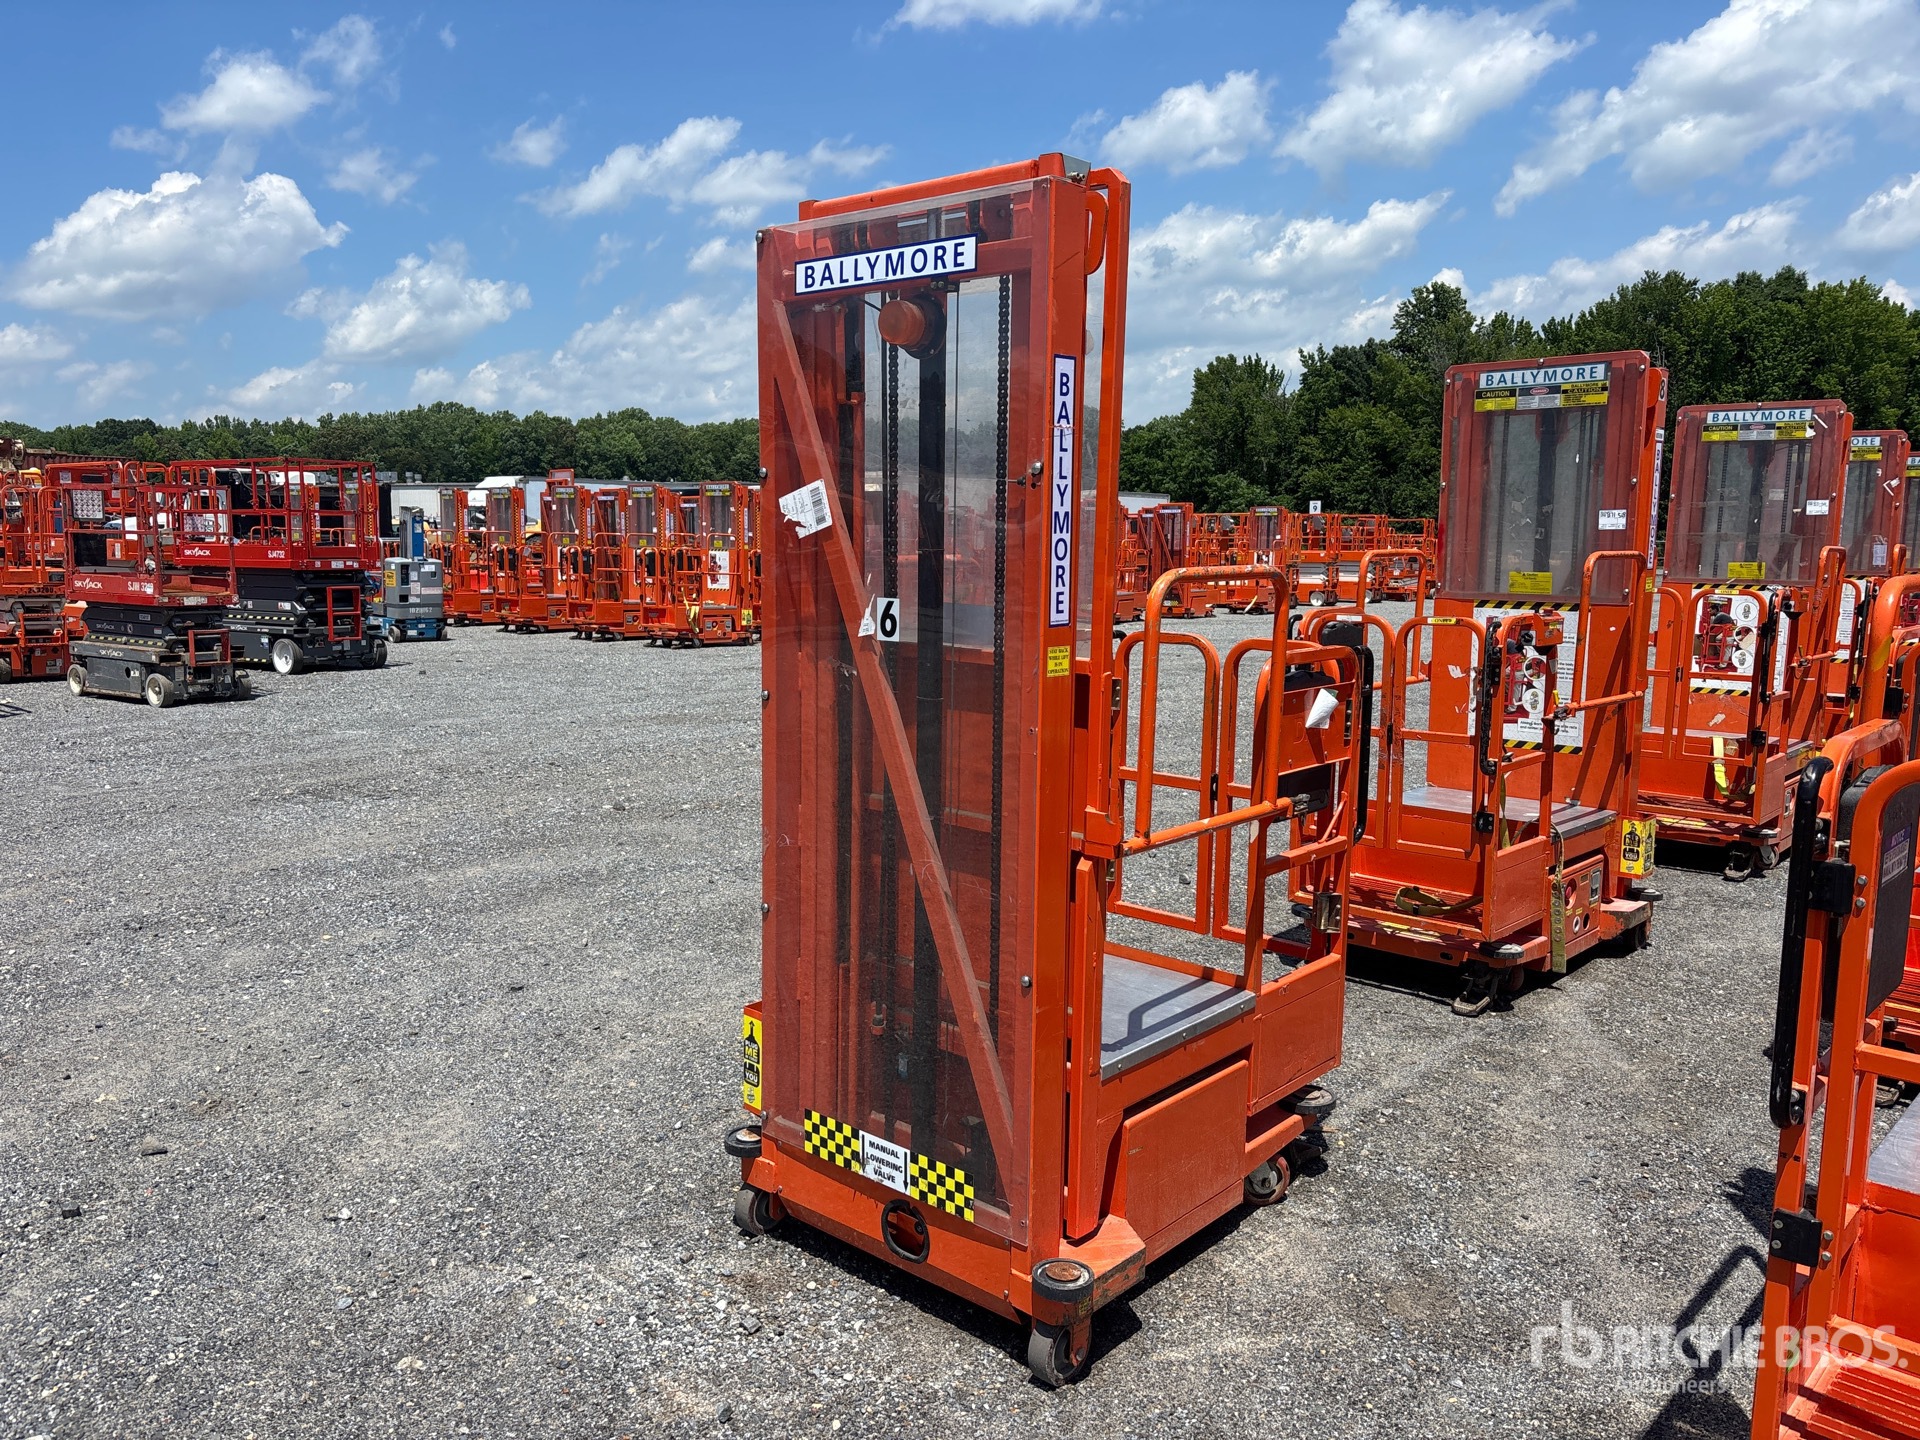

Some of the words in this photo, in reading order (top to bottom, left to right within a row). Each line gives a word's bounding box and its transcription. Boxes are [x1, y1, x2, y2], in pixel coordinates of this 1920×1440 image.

[804, 241, 966, 289] BALLYMORE
[1485, 366, 1598, 387] BALLYMORE
[1481, 390, 1510, 398] CAUTION
[1659, 378, 1666, 399] 8
[1711, 410, 1806, 423] BALLYMORE
[1053, 372, 1071, 616] BALLYMORE
[1648, 449, 1661, 565] BALLYMORE
[183, 547, 211, 557] SKYJACK
[267, 550, 285, 558] SJ4732
[74, 578, 102, 589] SKYJACK
[880, 600, 898, 638] 6
[99, 648, 124, 658] SKYJACK
[744, 1046, 759, 1059] ME
[744, 1071, 759, 1083] YOU
[868, 1140, 900, 1160] MANUAL
[866, 1151, 903, 1174] LOWERING
[873, 1166, 896, 1184] VALVE
